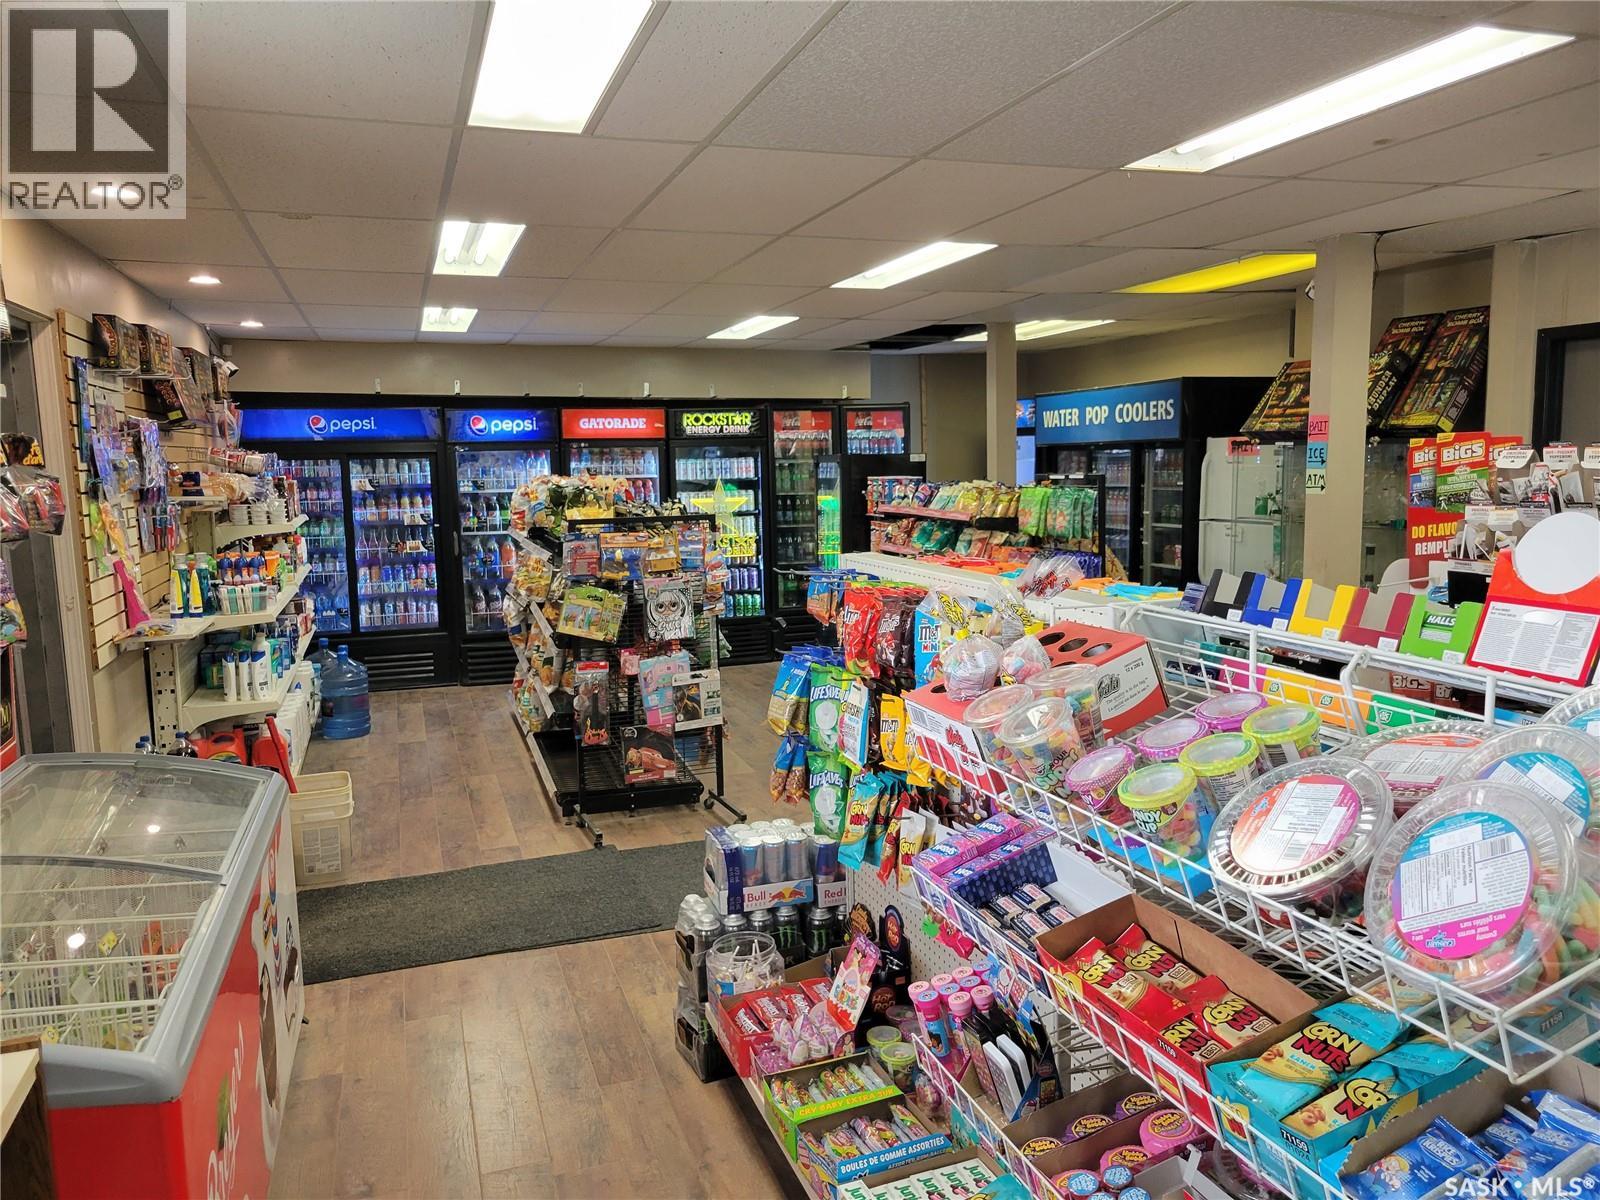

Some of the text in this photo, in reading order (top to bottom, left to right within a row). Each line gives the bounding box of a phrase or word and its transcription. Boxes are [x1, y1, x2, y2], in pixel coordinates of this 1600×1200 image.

[1043, 398, 1174, 428] WATER POP COOLERS
[330, 416, 377, 433] pepsi
[491, 416, 539, 435] pepsi
[579, 417, 647, 429] GATORADE
[685, 424, 750, 434] ENERGY DRINK
[1308, 447, 1325, 459] ICE
[1306, 473, 1326, 486] ATM
[1411, 521, 1457, 539] DO FLAVO
[1414, 538, 1451, 556] REMPL
[1426, 614, 1457, 627] HALLS
[747, 889, 766, 902] Bull
[824, 889, 843, 899] Red
[1301, 1020, 1363, 1054] CORN
[1290, 1034, 1352, 1073] NUTS
[799, 1088, 895, 1116] CRY BABY EXTRA SUR
[840, 1135, 945, 1173] BOULES DE GOMME ASSORTIES
[963, 1165, 991, 1181] Juni
[917, 1177, 943, 1194] Juni
